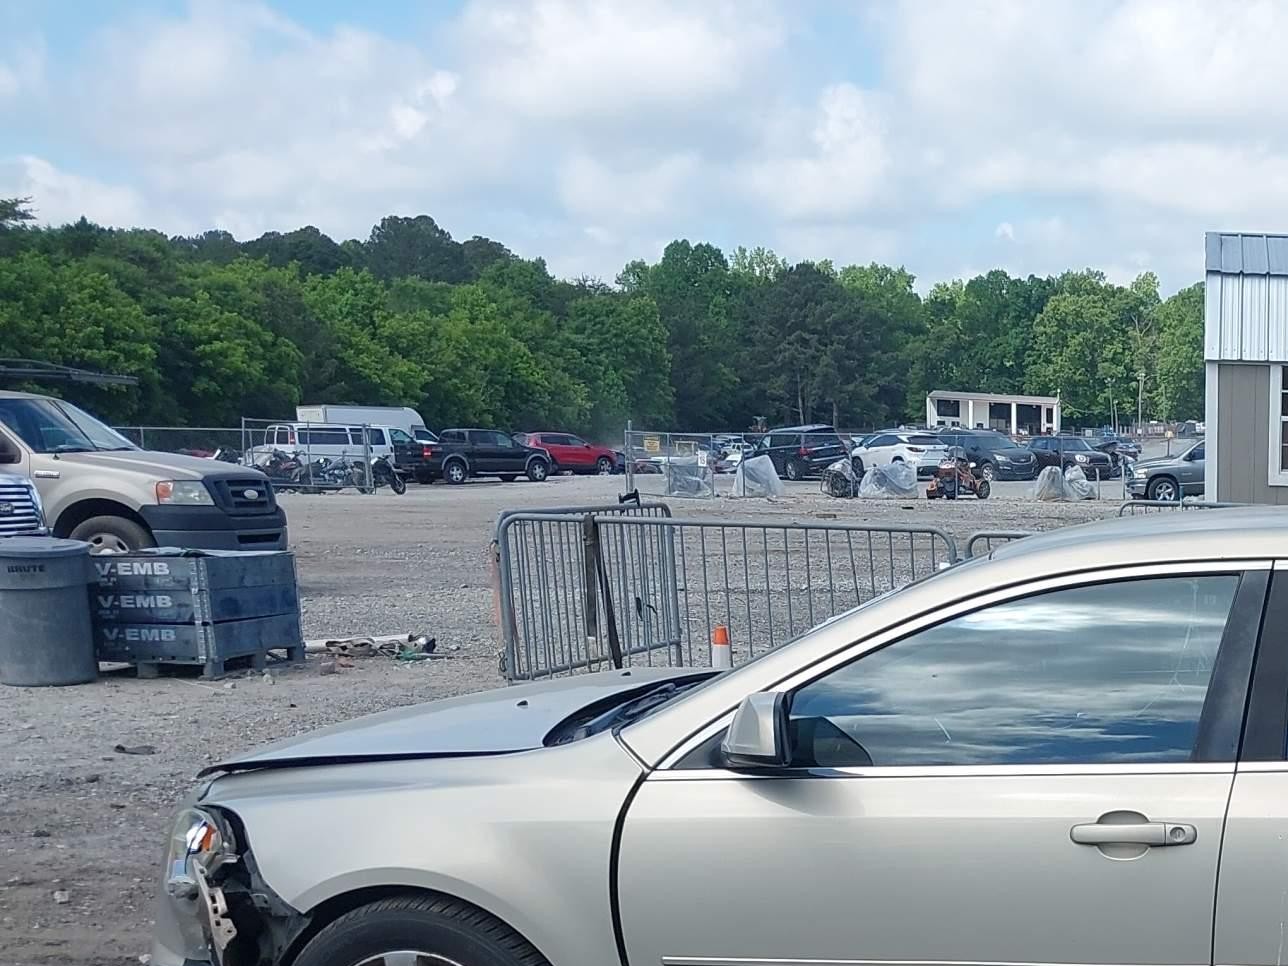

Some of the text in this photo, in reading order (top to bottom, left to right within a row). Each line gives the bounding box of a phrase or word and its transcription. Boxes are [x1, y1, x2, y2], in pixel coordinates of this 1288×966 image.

[95, 562, 170, 576] V-EMB
[98, 595, 173, 609] V-EMB
[103, 628, 177, 641] V-EMB
